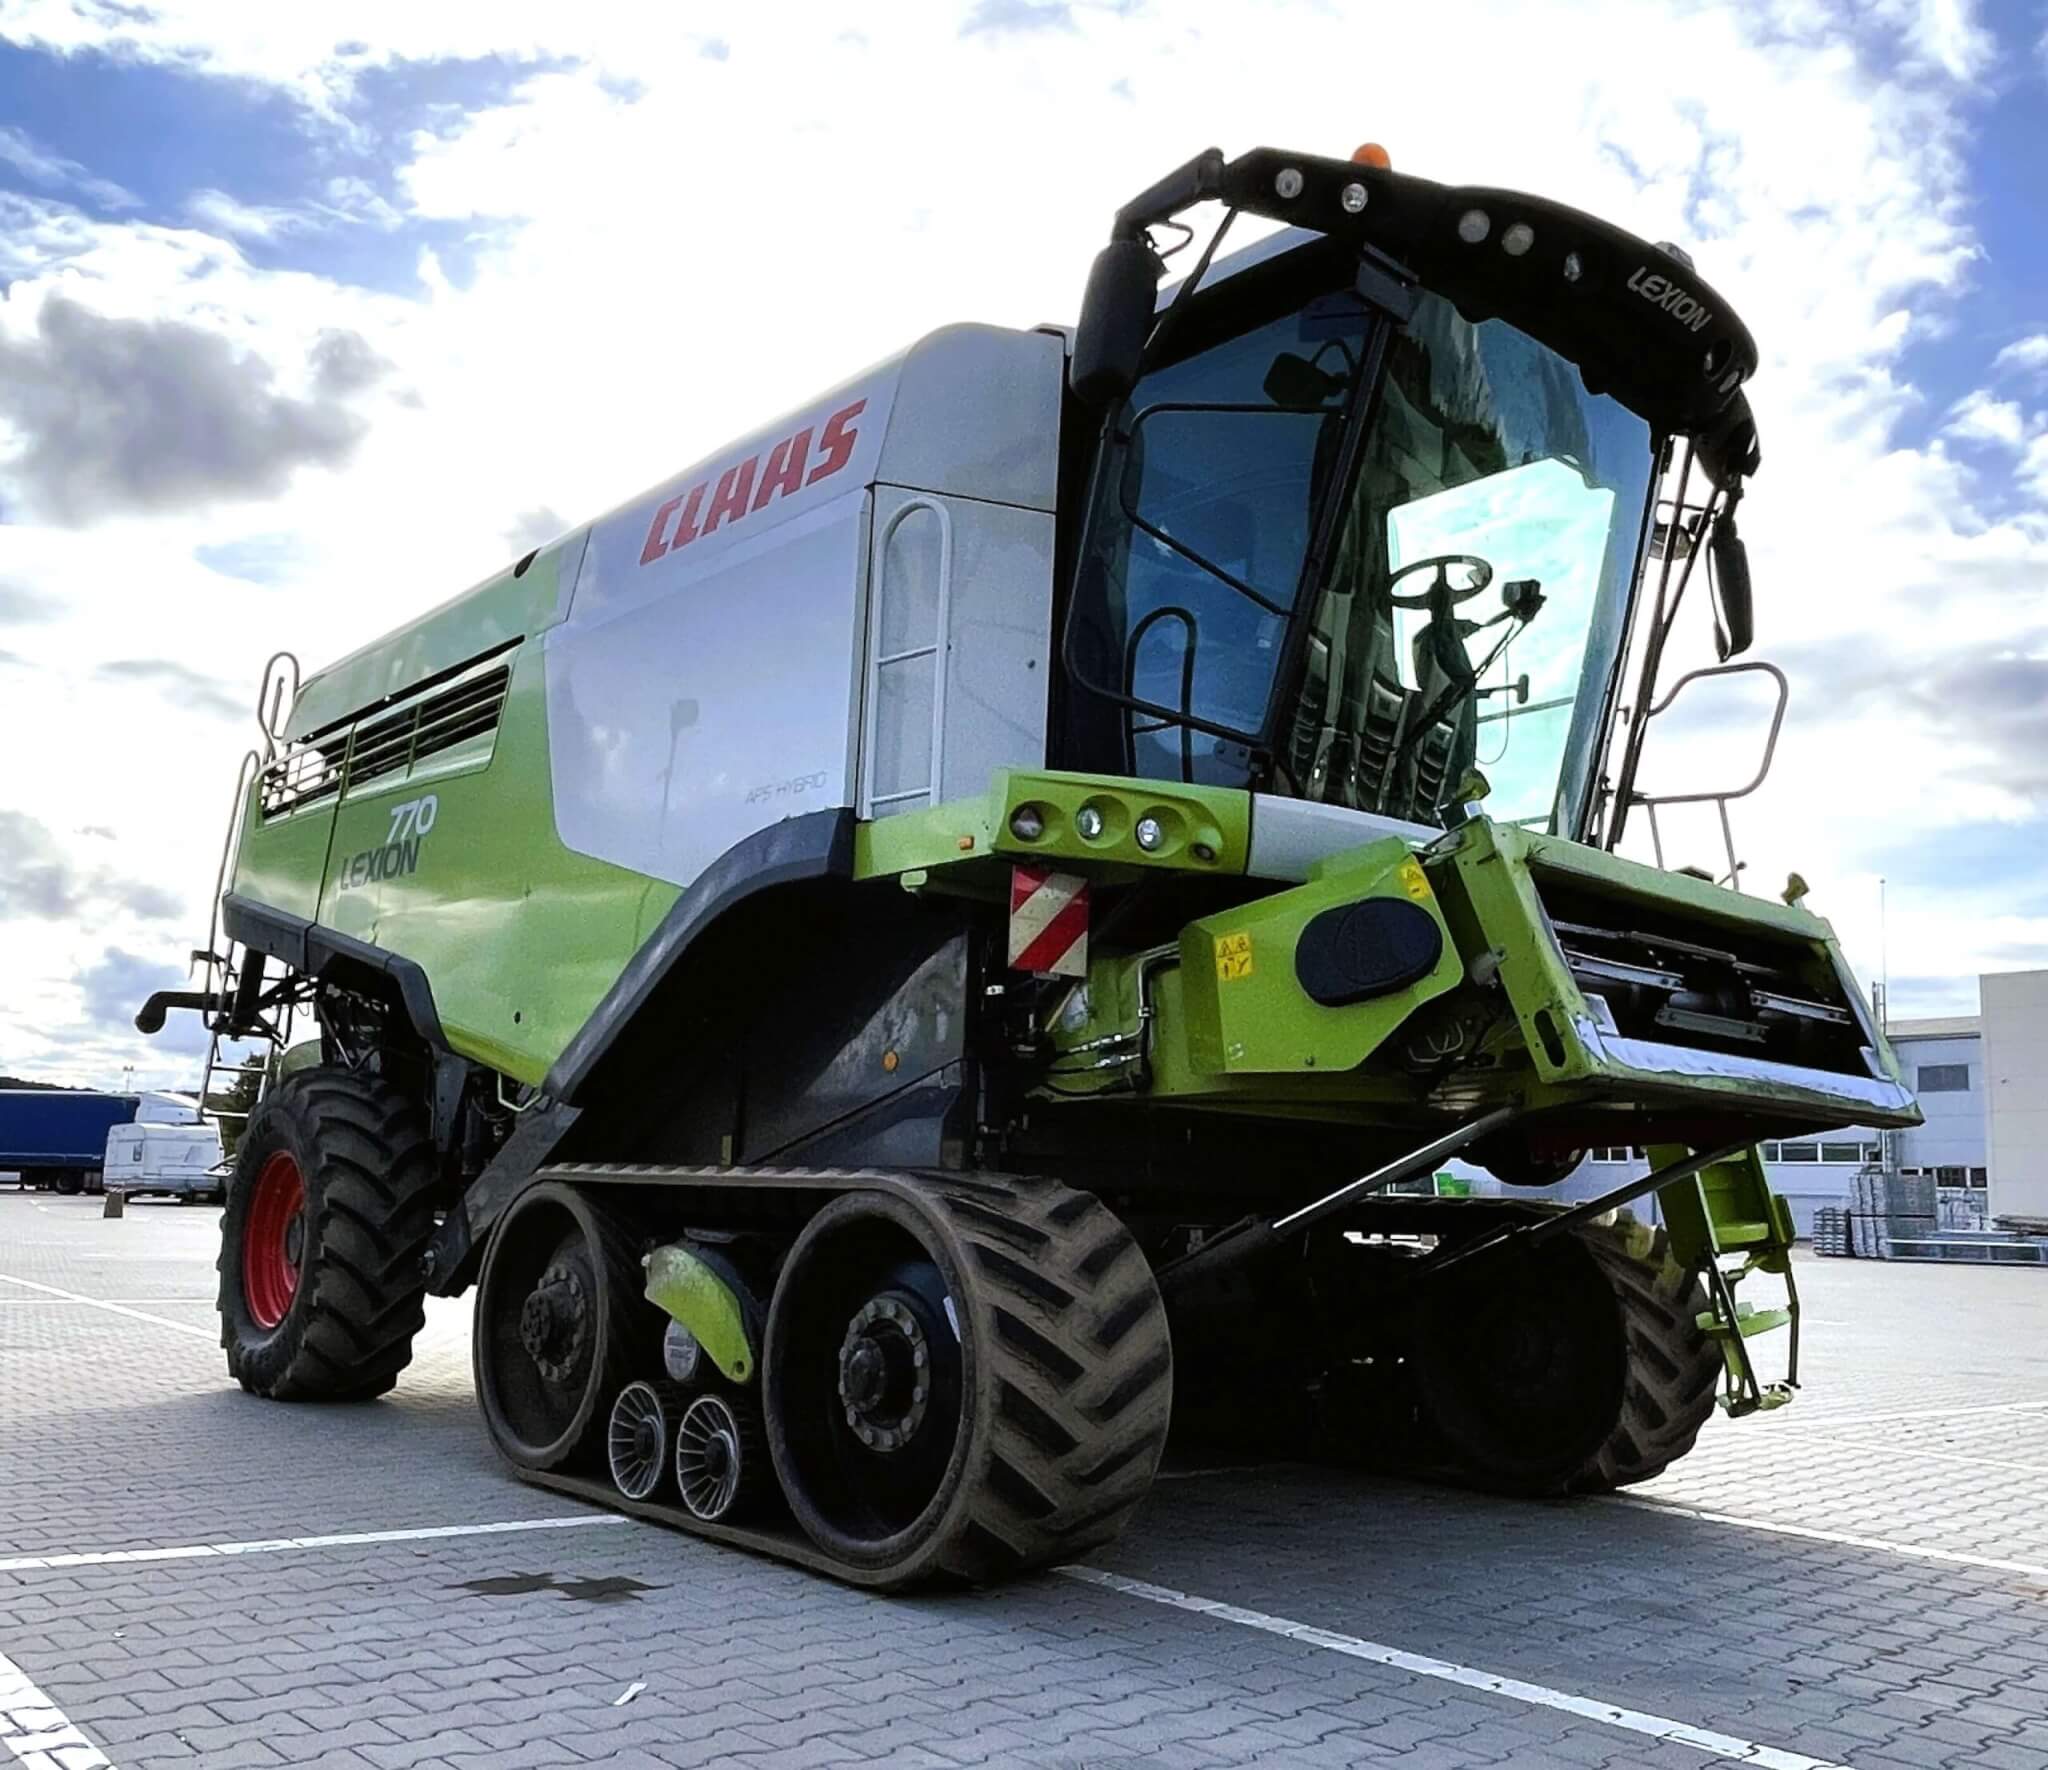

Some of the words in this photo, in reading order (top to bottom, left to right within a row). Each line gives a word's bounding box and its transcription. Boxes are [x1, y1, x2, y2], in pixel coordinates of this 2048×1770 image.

[1627, 266, 1713, 332] LEXION
[640, 397, 868, 567] CLAAS
[386, 794, 438, 845] 770
[340, 836, 421, 891] LEXION
